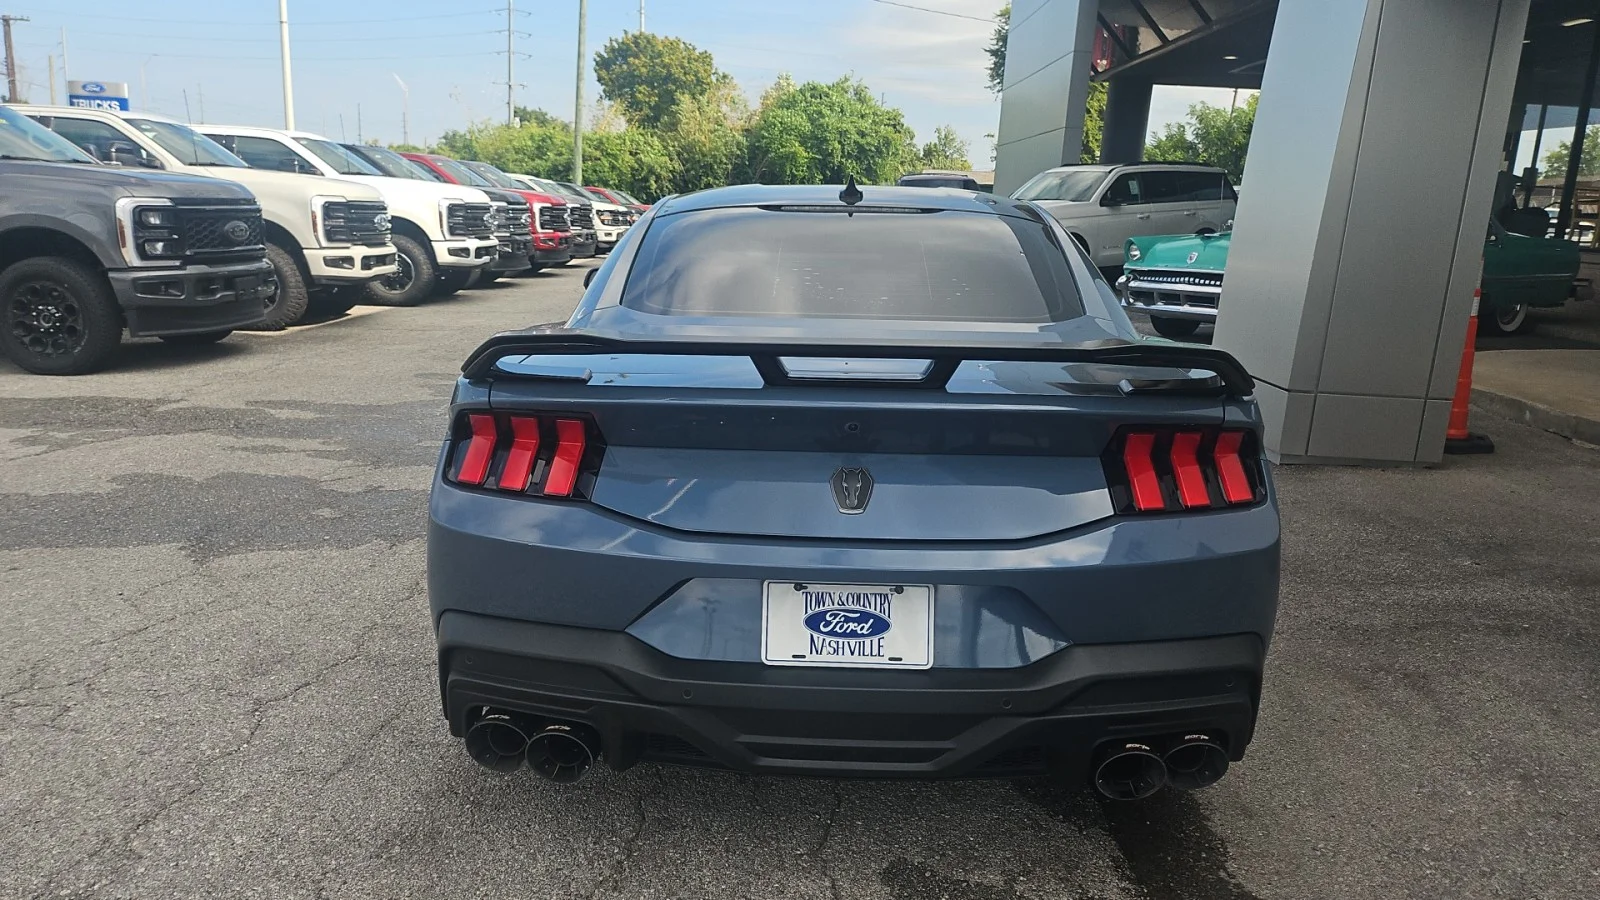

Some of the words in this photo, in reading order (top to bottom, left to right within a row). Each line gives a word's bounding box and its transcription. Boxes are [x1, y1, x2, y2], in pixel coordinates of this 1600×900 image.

[71, 98, 121, 111] TRUCKS
[802, 591, 836, 615] TOWN
[837, 591, 845, 607] &
[844, 592, 894, 620] COUNTRY
[820, 610, 873, 635] Ford
[809, 633, 885, 657] NASHVILLE
